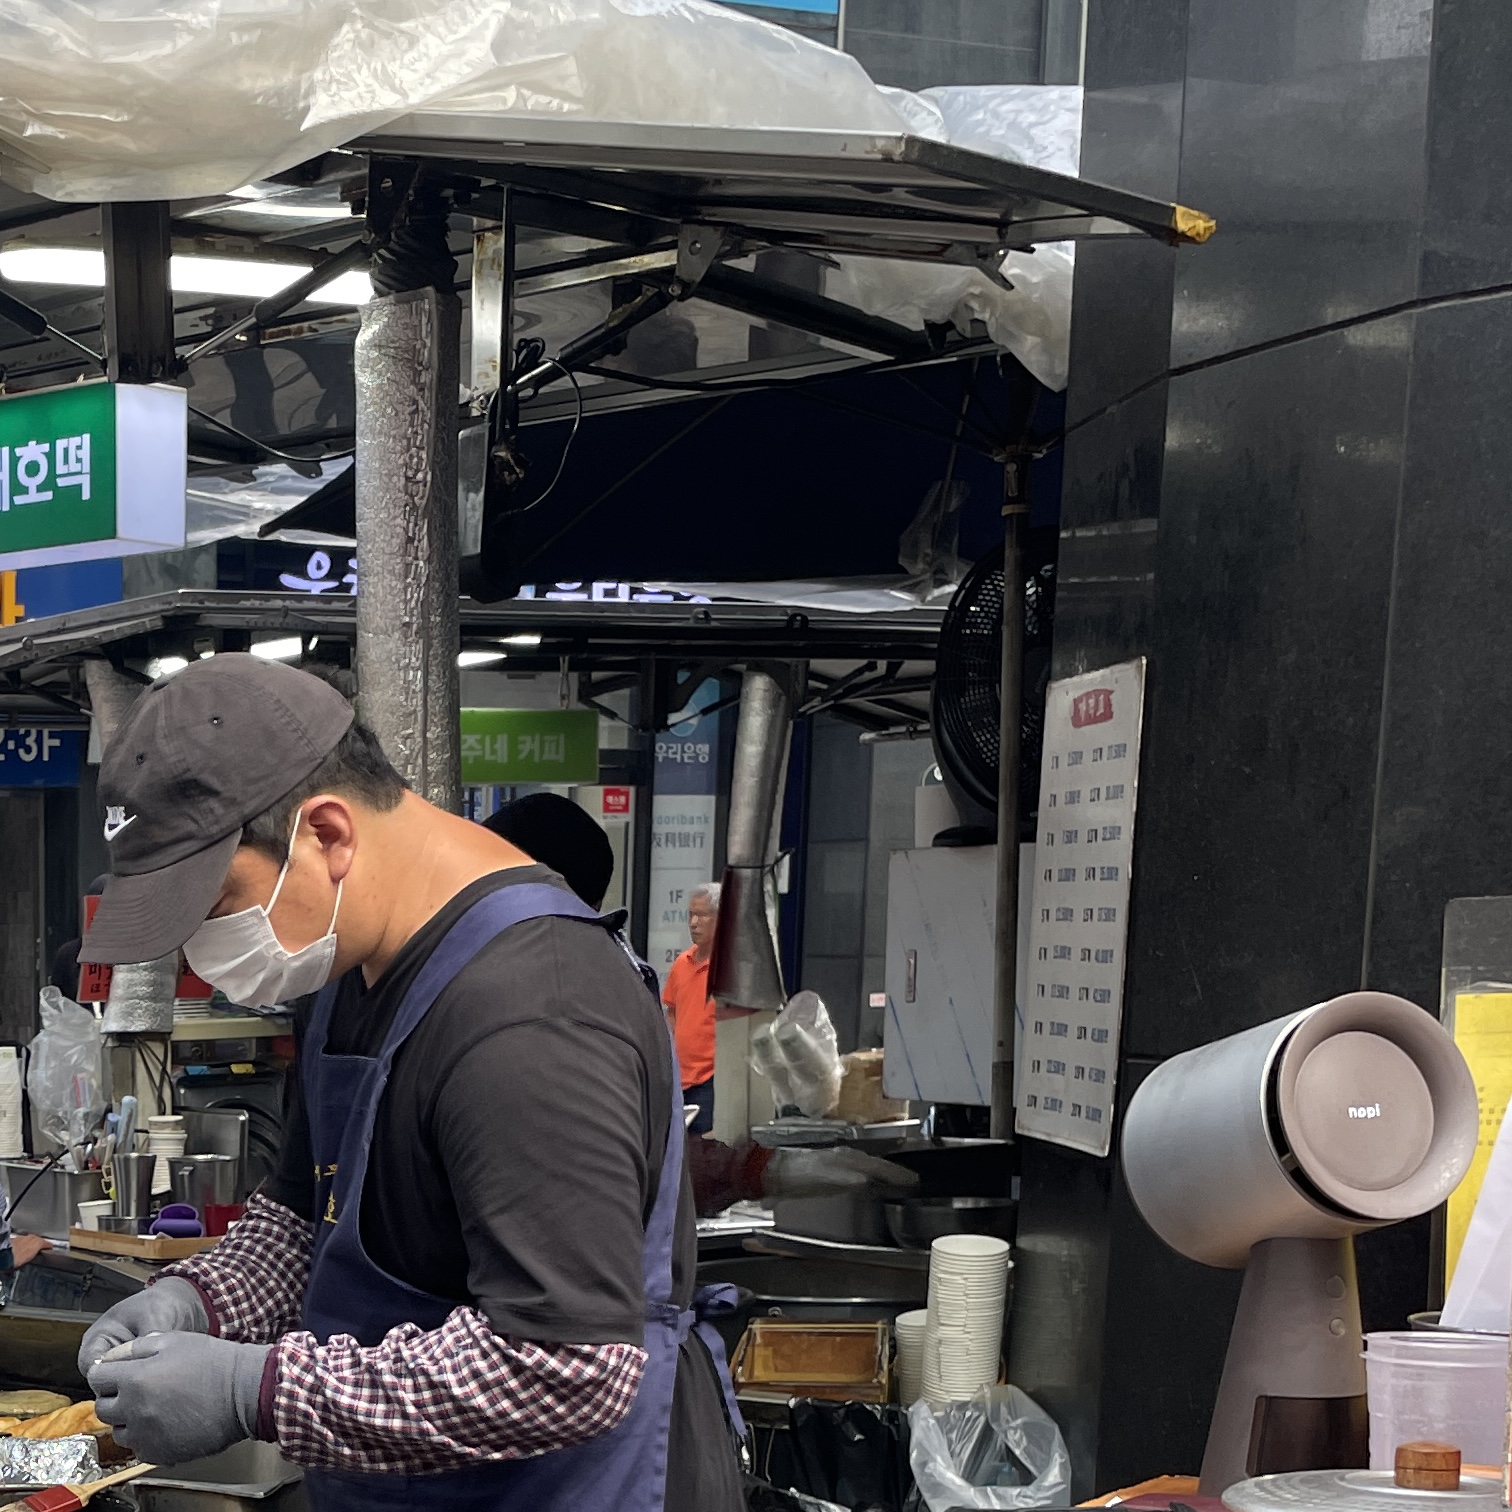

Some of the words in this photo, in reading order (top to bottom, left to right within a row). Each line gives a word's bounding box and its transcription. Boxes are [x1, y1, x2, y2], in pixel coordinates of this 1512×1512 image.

[518, 733, 566, 763] 커피
[654, 742, 711, 763] 우리은행
[669, 889, 683, 904] 1F
